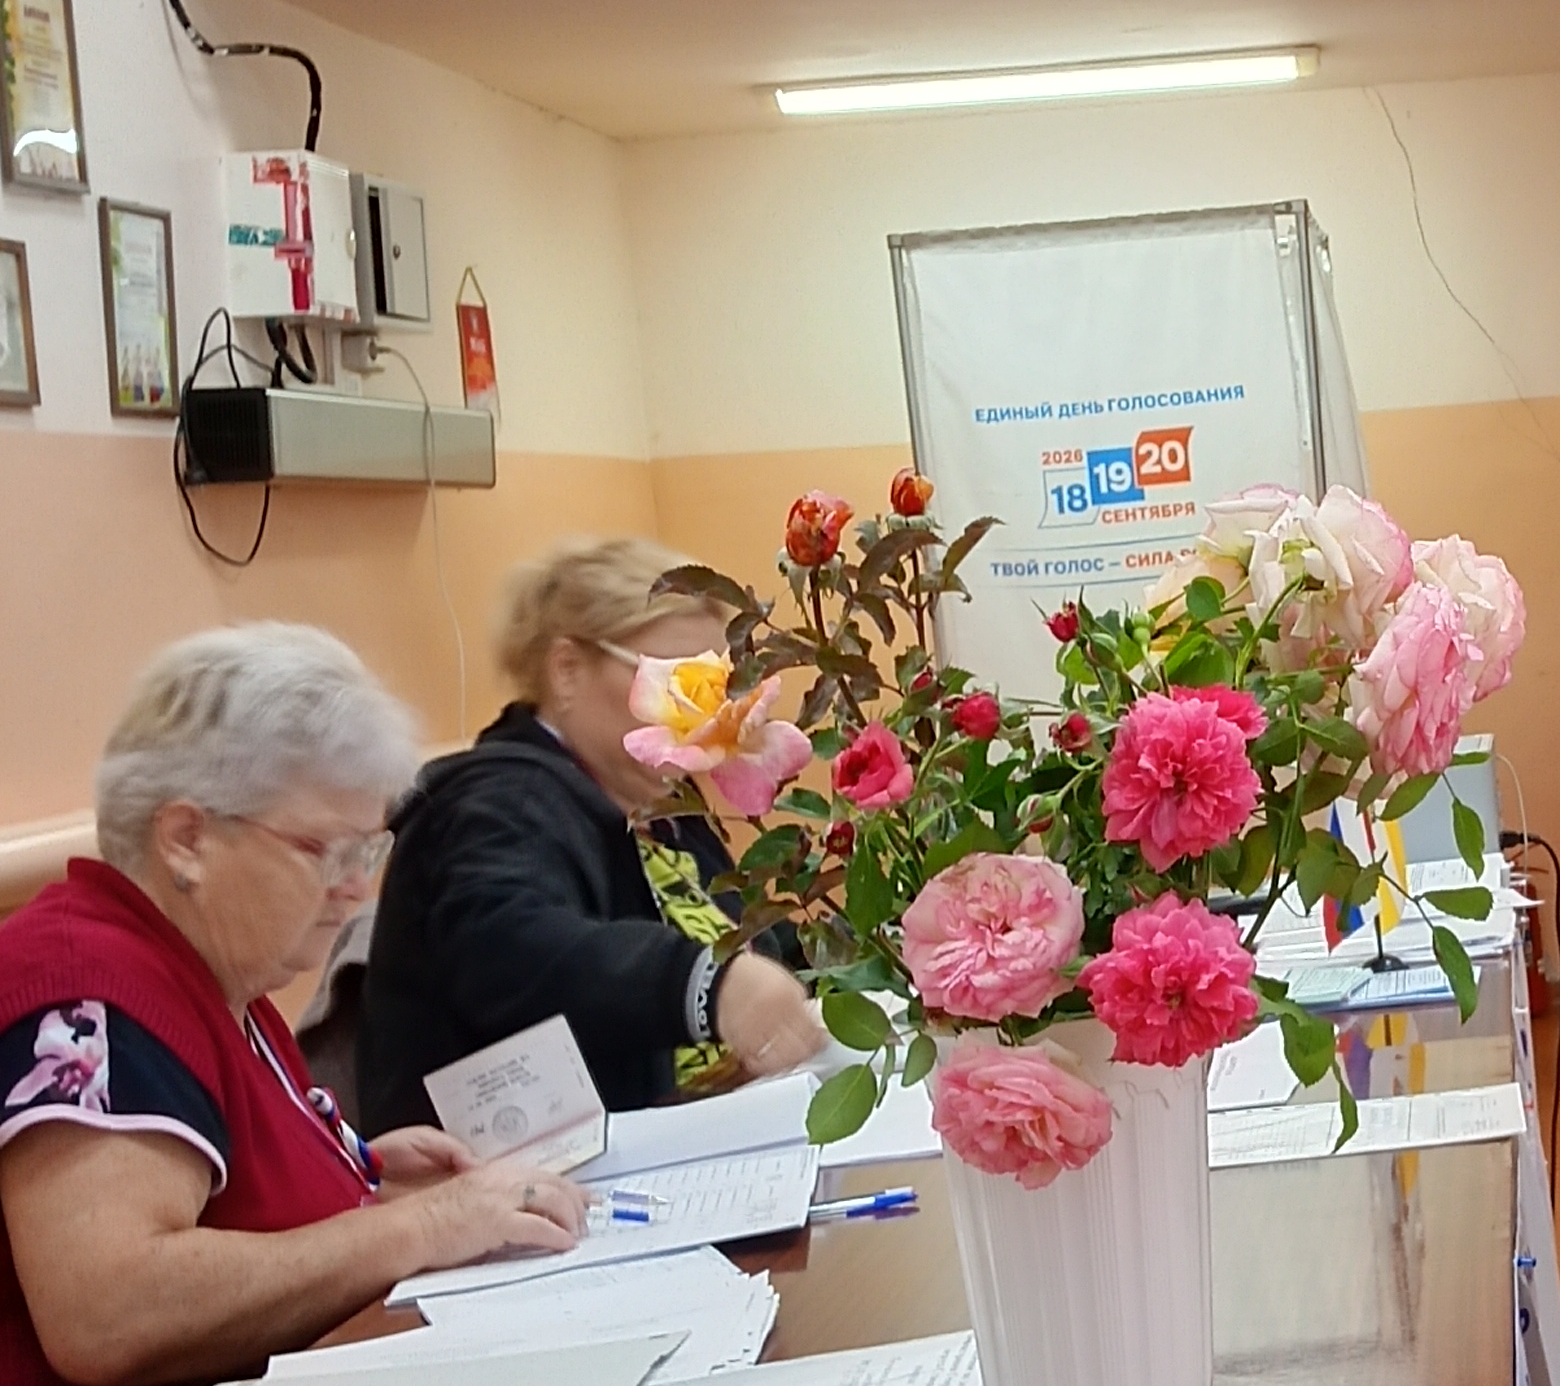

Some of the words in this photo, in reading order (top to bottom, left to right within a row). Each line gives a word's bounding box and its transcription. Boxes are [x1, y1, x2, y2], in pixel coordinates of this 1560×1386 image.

[975, 401, 1053, 424] ЕДИНЫЙ
[1058, 400, 1104, 419] ДЕНЬ
[1107, 385, 1245, 413] ГОЛОСОВАНИЯ
[1042, 449, 1083, 465] 2026
[1051, 484, 1088, 514] 18
[1093, 461, 1131, 494] 19
[1138, 440, 1185, 475] 20
[1102, 502, 1195, 524] СЕНТЯБРЯ
[990, 559, 1039, 577] ТВОЙ
[1045, 558, 1104, 575] ГОЛОС
[1125, 551, 1173, 568] СИЛА
